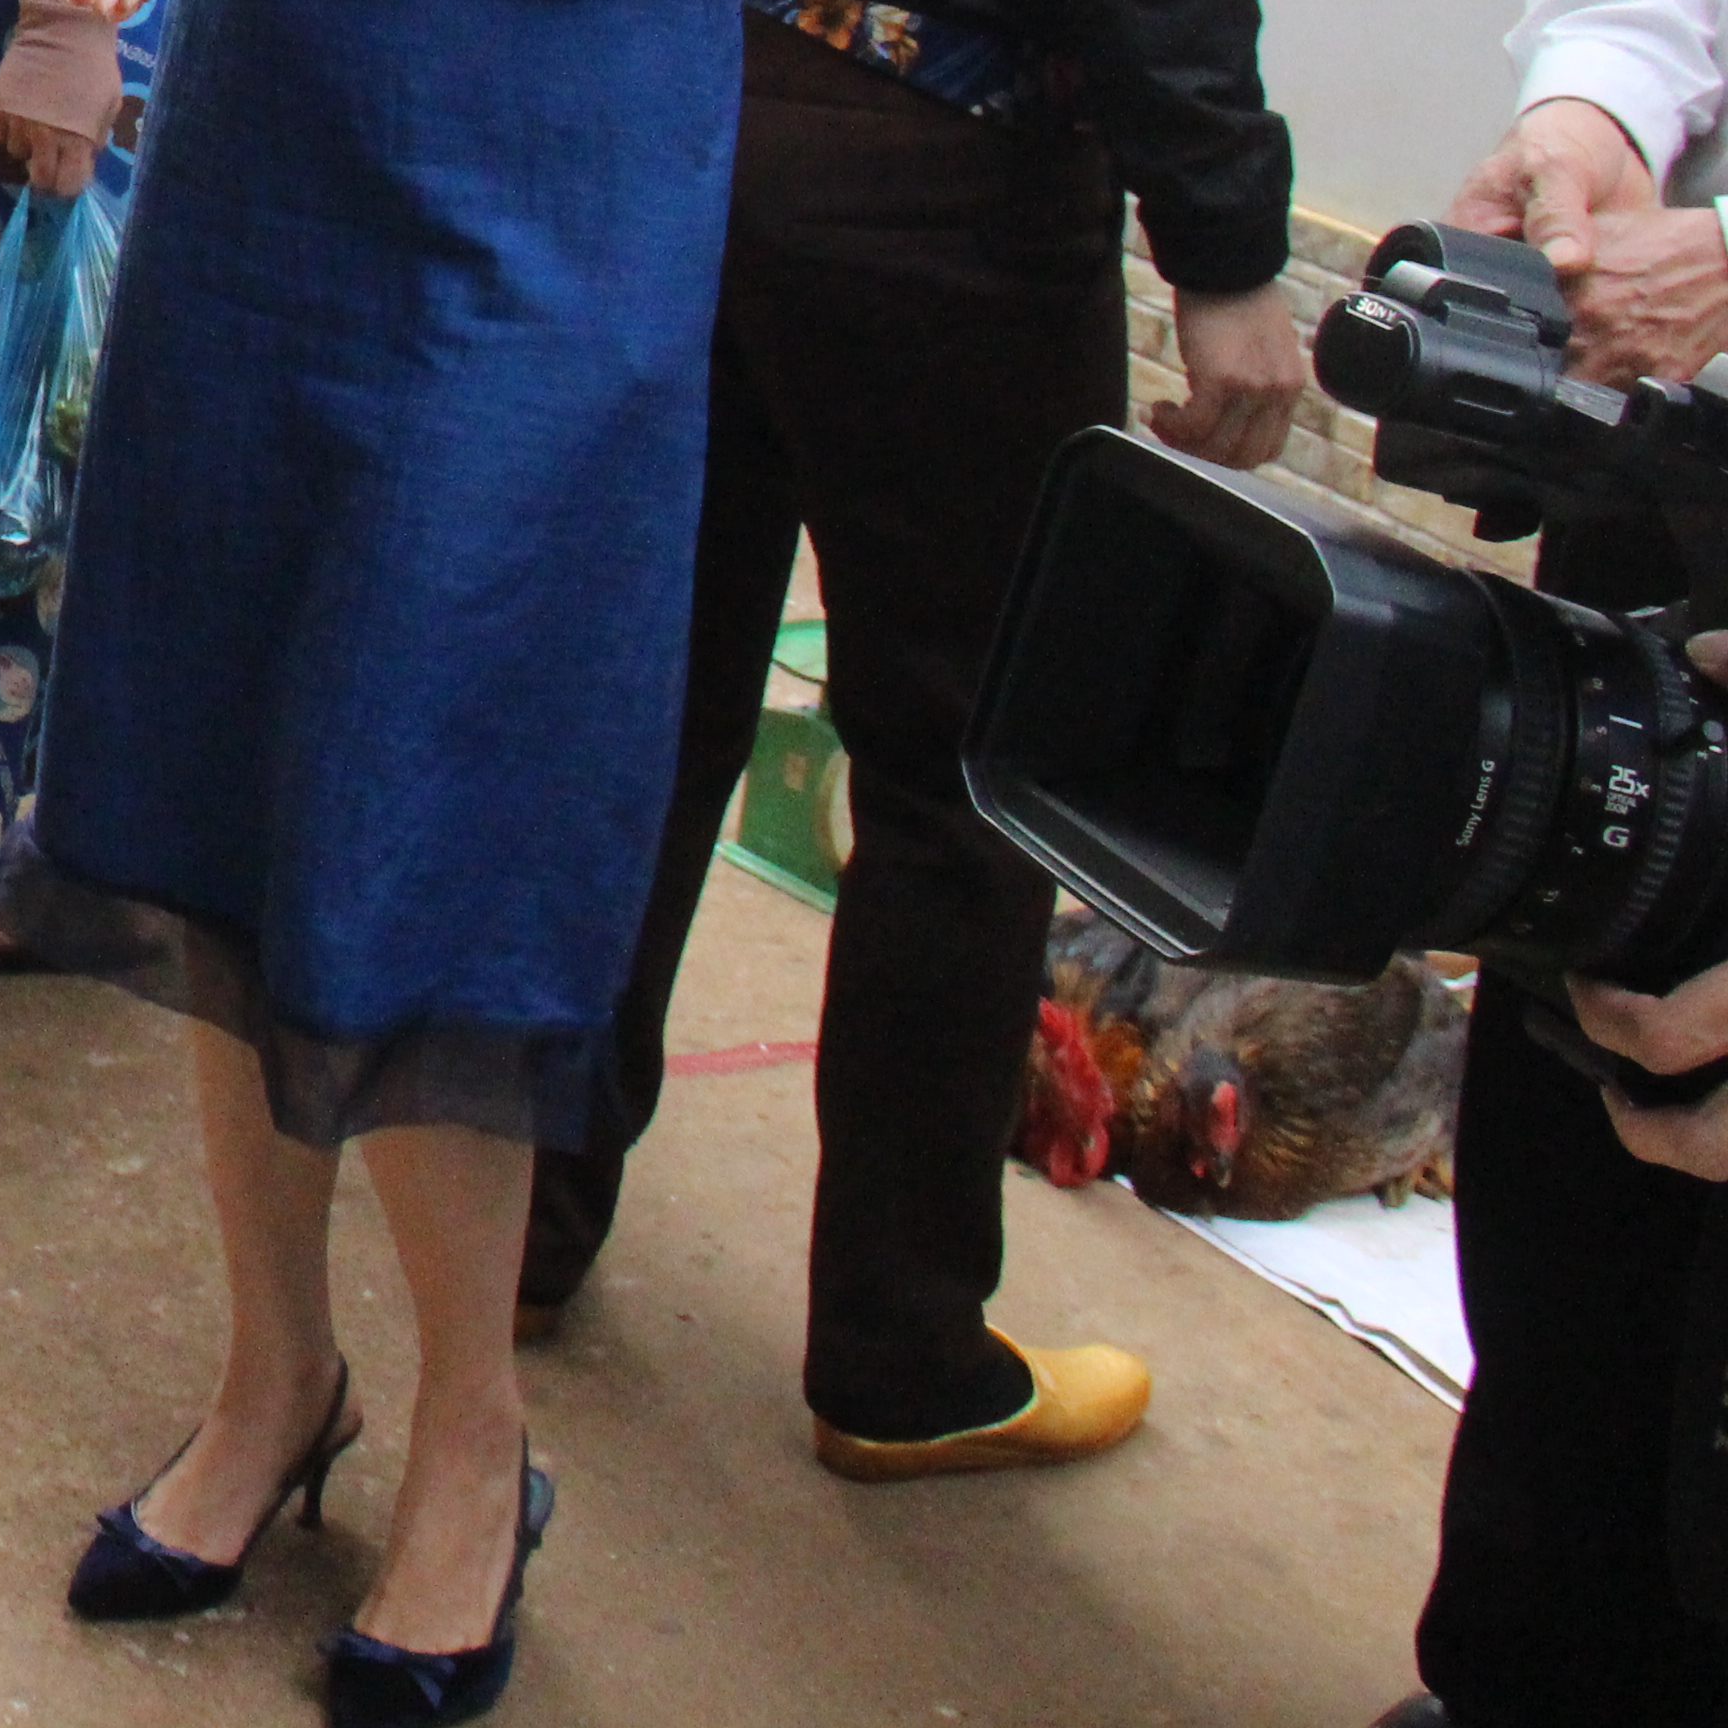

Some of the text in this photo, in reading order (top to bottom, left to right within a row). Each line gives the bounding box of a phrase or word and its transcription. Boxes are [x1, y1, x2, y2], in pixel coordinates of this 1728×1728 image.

[1355, 295, 1403, 324] SONY
[1455, 758, 1495, 847] Sony Lens G
[1602, 824, 1630, 849] G
